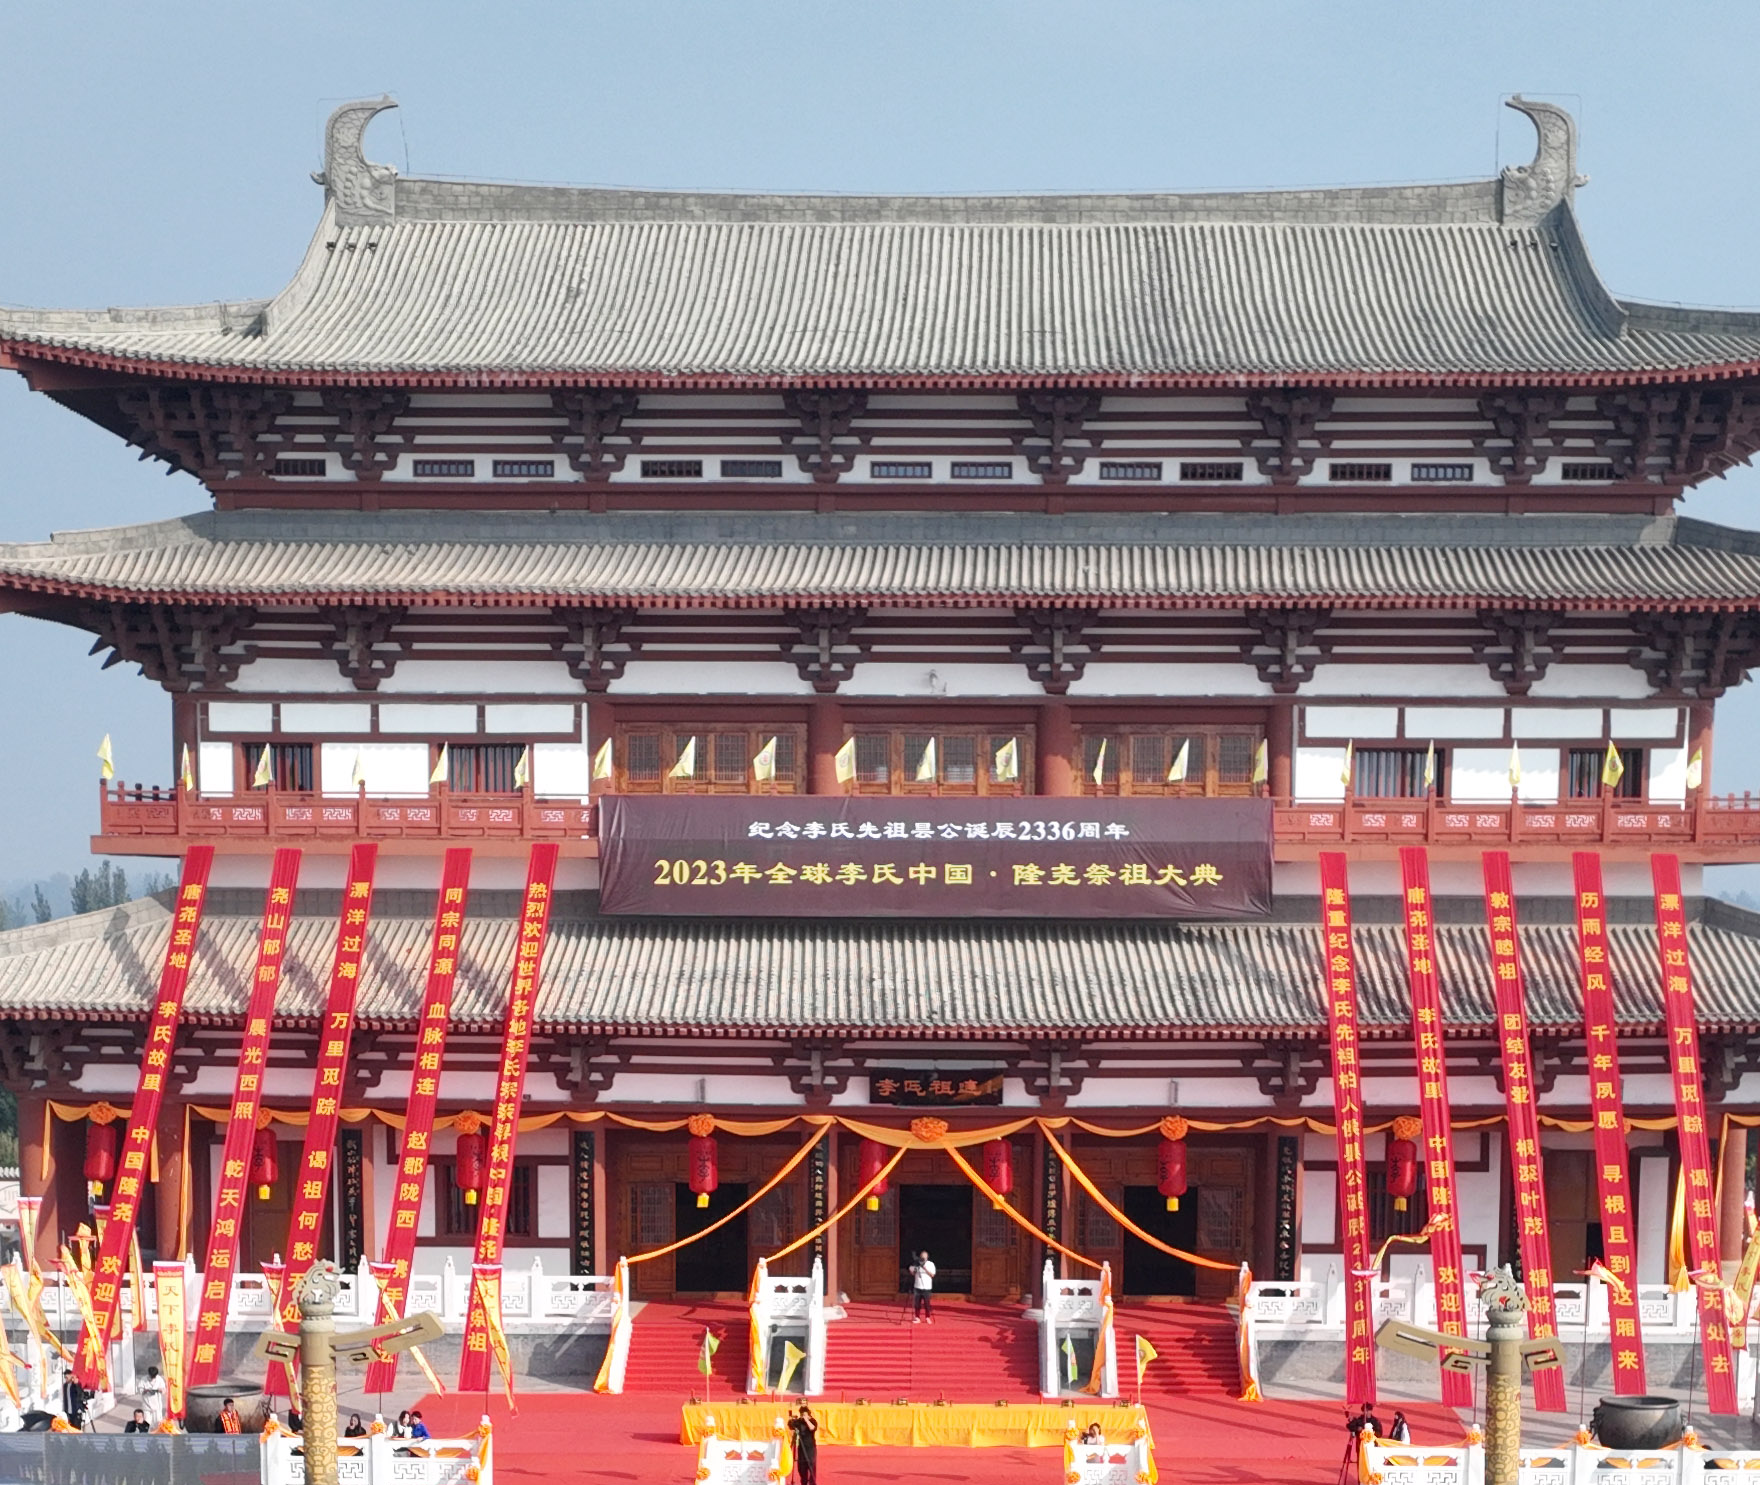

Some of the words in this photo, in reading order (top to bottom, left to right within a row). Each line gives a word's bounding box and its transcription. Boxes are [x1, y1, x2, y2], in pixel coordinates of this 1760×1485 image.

[653, 859, 1224, 886] 2023年全球李氏中国·隆尧祭祖大典
[747, 820, 1131, 841] 纪念李氏先祖昙公诞辰2336周年
[169, 883, 203, 969] 唐尧圣地
[258, 886, 289, 982] 尧山郁郁
[337, 881, 370, 979] 漂洋过海
[434, 887, 463, 975] 同宗同源
[1407, 886, 1433, 975] 唐尧圣地
[1580, 891, 1607, 991] 历雨经风
[1660, 893, 1689, 993] 漂洋过海
[141, 1000, 178, 1091] 李氏故里
[315, 1012, 350, 1116] 万里觅踪
[415, 1001, 446, 1096] 血脉相连
[1417, 1007, 1443, 1099] 李氏故里
[1503, 1013, 1529, 1105] 团结友爱
[1591, 1024, 1618, 1130] 千年夙愿
[1674, 1027, 1703, 1133] 万里觅踪
[113, 1125, 150, 1223] 中国隆尧
[395, 1131, 428, 1229] 赵郡陇西
[1515, 1138, 1543, 1235] 根深叶茂
